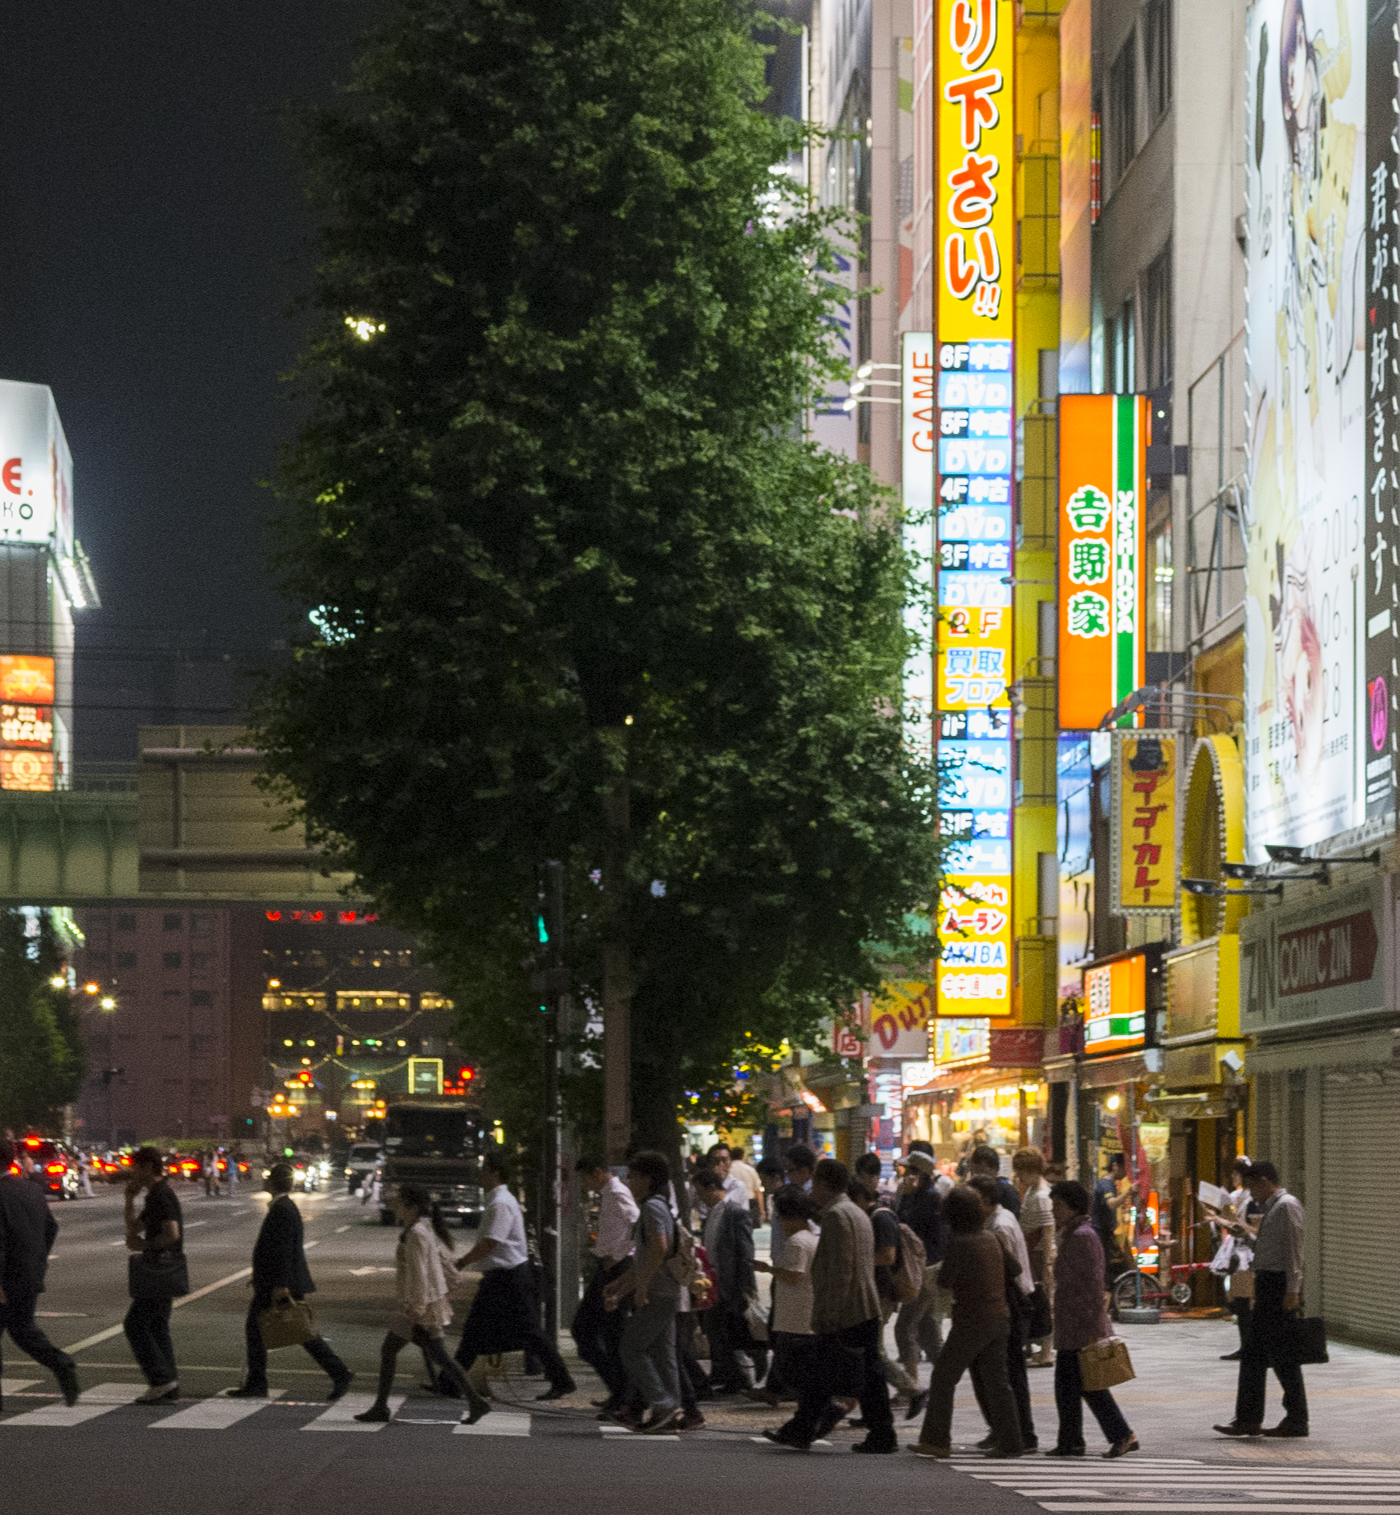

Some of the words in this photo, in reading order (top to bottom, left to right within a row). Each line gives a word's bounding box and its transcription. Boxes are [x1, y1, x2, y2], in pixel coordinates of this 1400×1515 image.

[940, 344, 969, 370] 6F
[944, 382, 1009, 407] DVD
[940, 410, 969, 436] 5F
[944, 449, 1009, 474] DVD
[940, 476, 969, 501] 4F
[944, 515, 1008, 540] DVD
[1321, 495, 1359, 574] 2013
[940, 542, 969, 568] 3F
[1069, 486, 1111, 637] 吉野家
[944, 583, 1008, 607] DVD
[946, 648, 1003, 675] 買取
[945, 677, 1005, 703] フロア
[1131, 769, 1168, 904] ゴーゴーカレー
[1281, 927, 1327, 992] COMIC
[1330, 923, 1352, 981] ZIN
